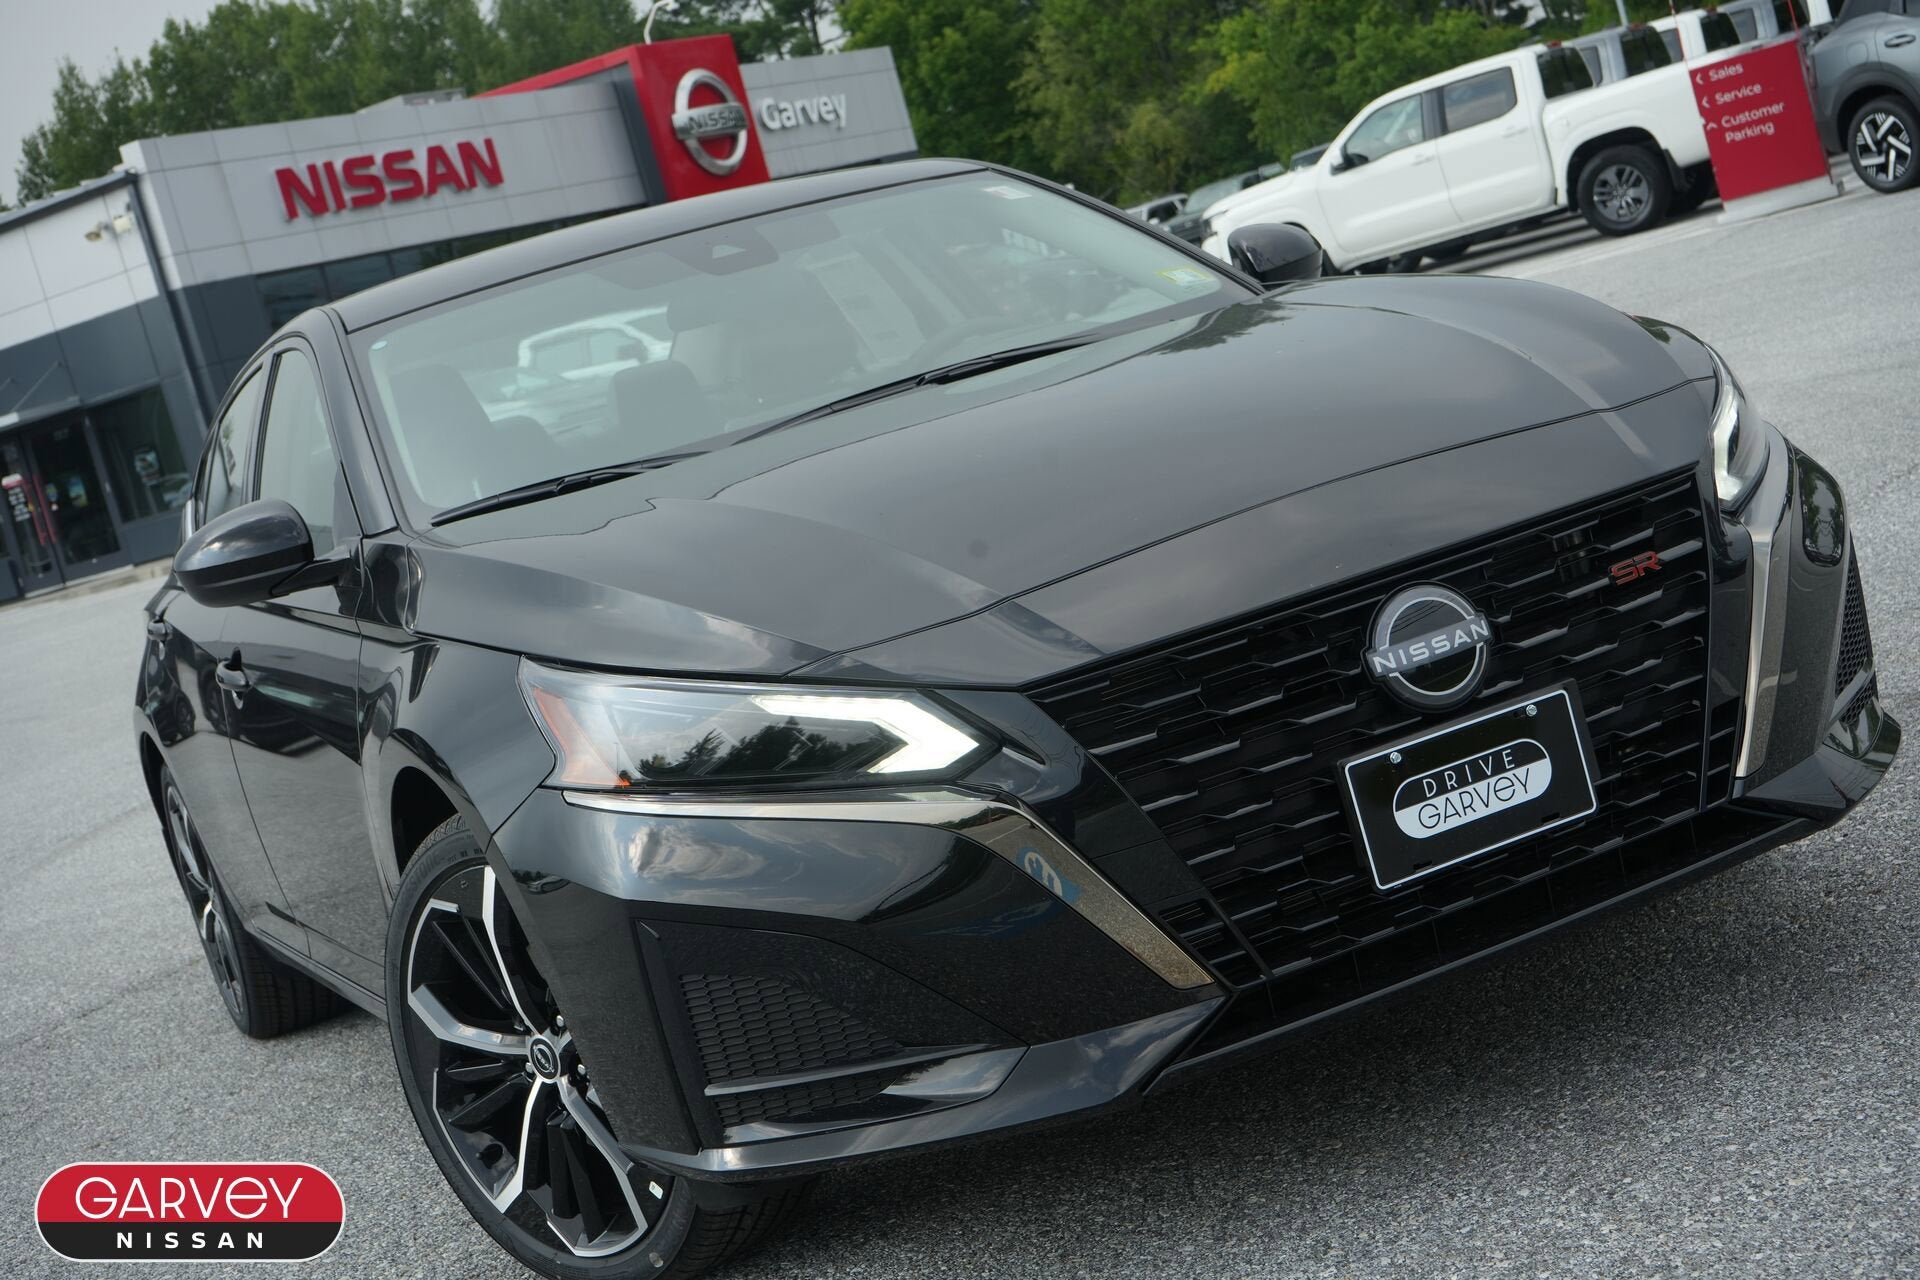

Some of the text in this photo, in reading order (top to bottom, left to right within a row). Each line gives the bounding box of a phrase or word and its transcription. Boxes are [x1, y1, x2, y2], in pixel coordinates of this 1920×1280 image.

[1709, 63, 1744, 81] Sales
[1715, 83, 1763, 105] Service
[761, 94, 846, 130] Garvey
[1721, 102, 1785, 128] Customer
[1725, 121, 1775, 143] Parking
[275, 137, 504, 222] NISSAN
[1610, 551, 1662, 586] SR
[1372, 619, 1489, 673] NISSAN
[1422, 749, 1515, 798] DRIVE
